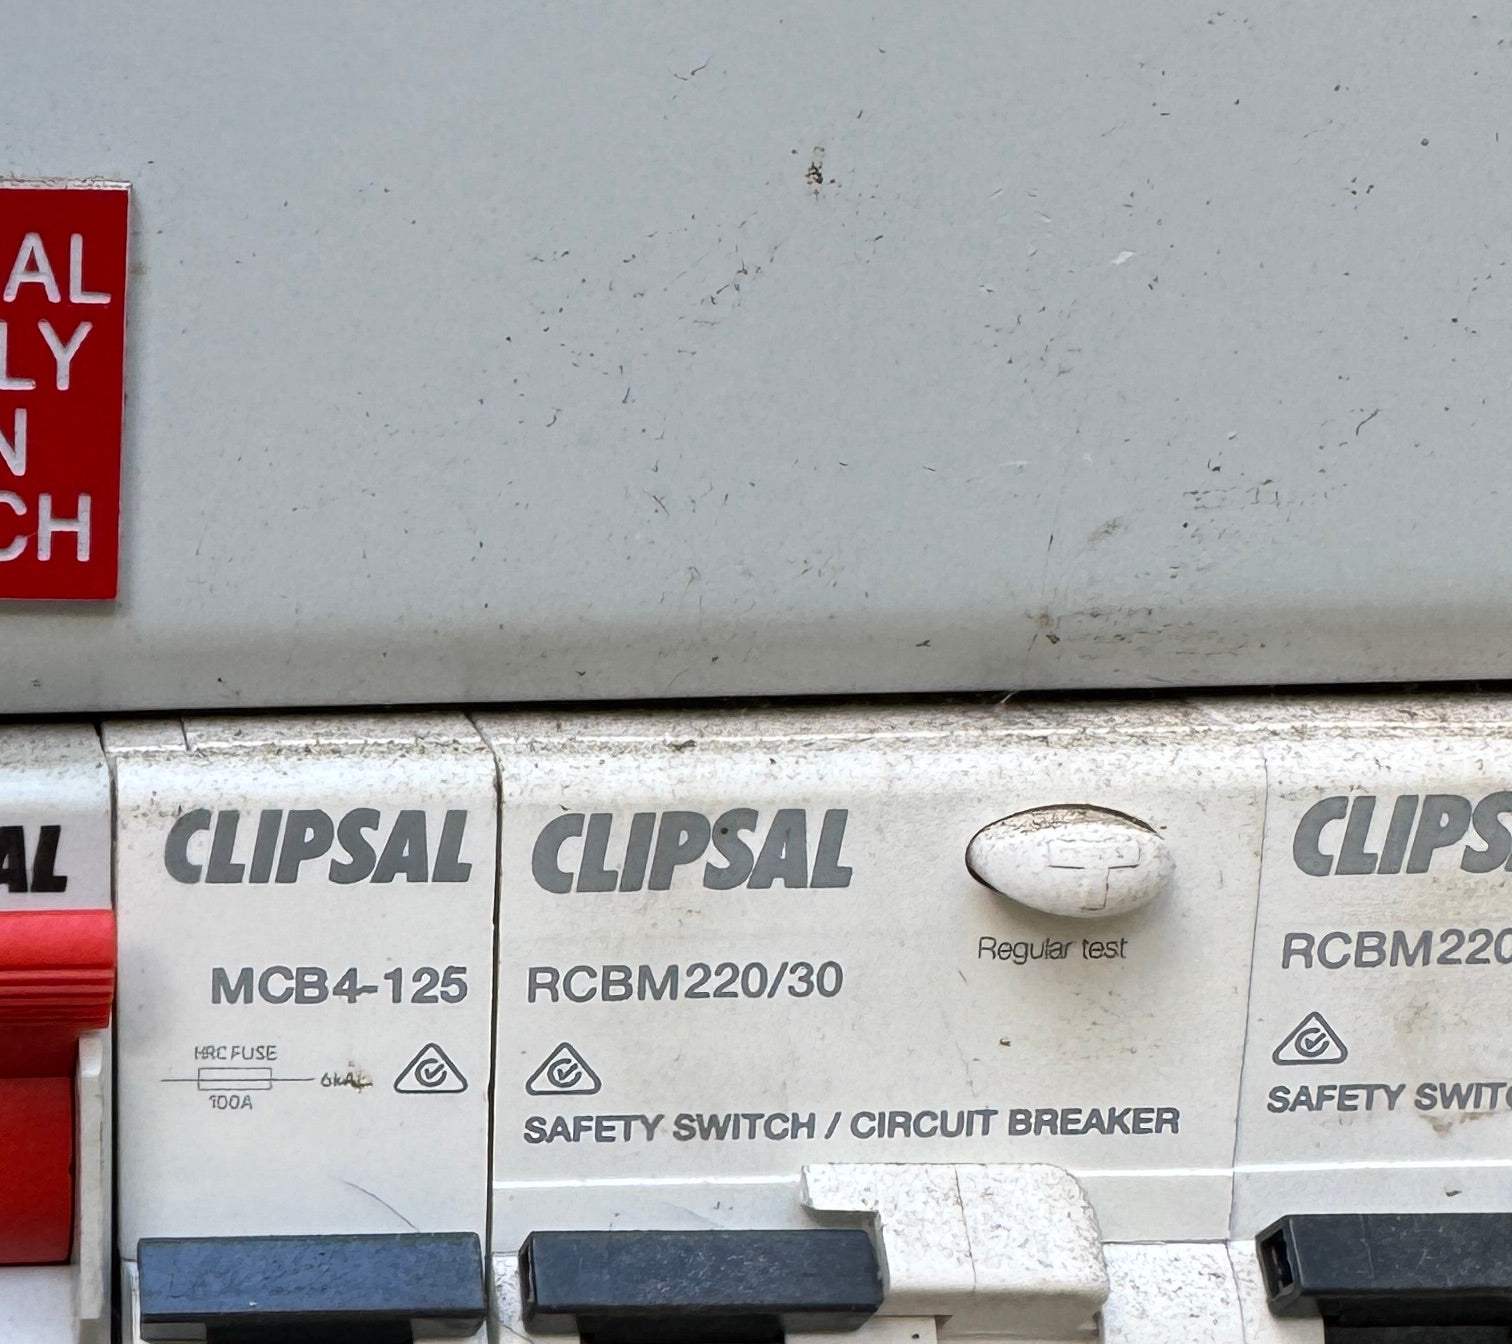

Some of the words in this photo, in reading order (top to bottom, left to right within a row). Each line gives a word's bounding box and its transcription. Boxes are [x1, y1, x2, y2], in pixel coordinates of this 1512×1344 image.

[164, 807, 473, 885] CLIPSAL
[531, 807, 853, 895] CLIPSAL
[1292, 790, 1512, 877] CLIPS
[978, 936, 1073, 965] Regular
[1082, 937, 1128, 959] test
[211, 965, 468, 1005] MCB4-125
[527, 960, 844, 1004] RCBM220/30
[229, 1045, 278, 1060] FUSE
[208, 1094, 254, 1111] 100A
[1267, 1083, 1406, 1114] SAFETY
[1414, 1081, 1512, 1112] SWIT
[524, 1113, 665, 1145] SAFETY
[673, 1111, 816, 1142] SWITCH
[850, 1109, 999, 1138] CIRCUIT
[1008, 1106, 1180, 1136] BREAKER
